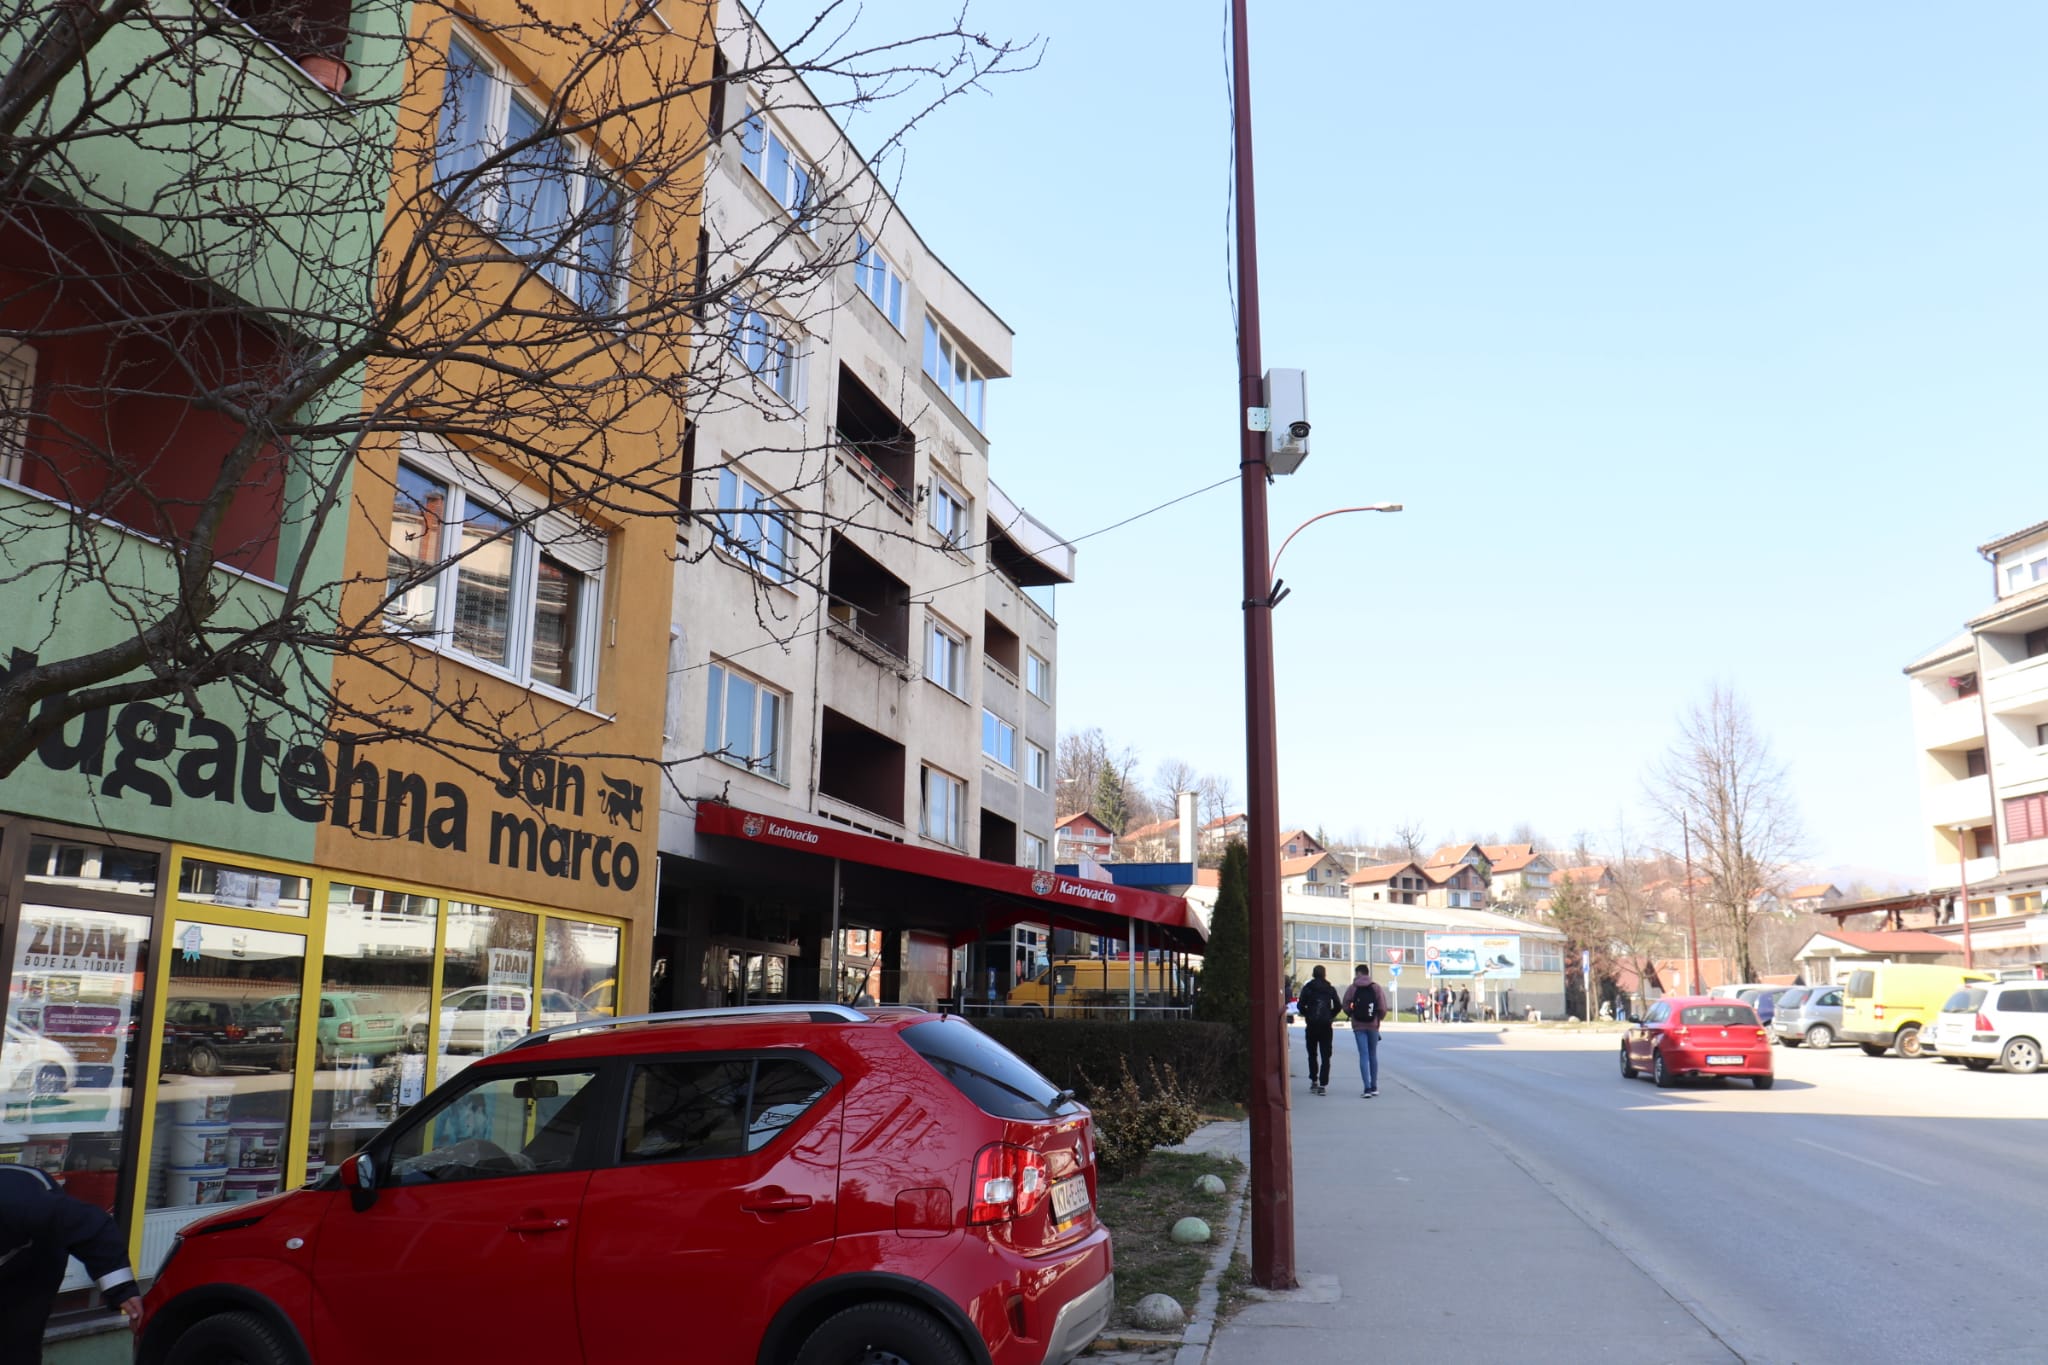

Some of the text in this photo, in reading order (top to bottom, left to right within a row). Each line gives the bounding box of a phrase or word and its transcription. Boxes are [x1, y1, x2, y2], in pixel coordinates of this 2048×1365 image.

[0, 645, 468, 853] ugatehna
[495, 746, 586, 817] san
[489, 811, 640, 891] marco
[24, 955, 126, 973] BOJE ZA ZIDOVE
